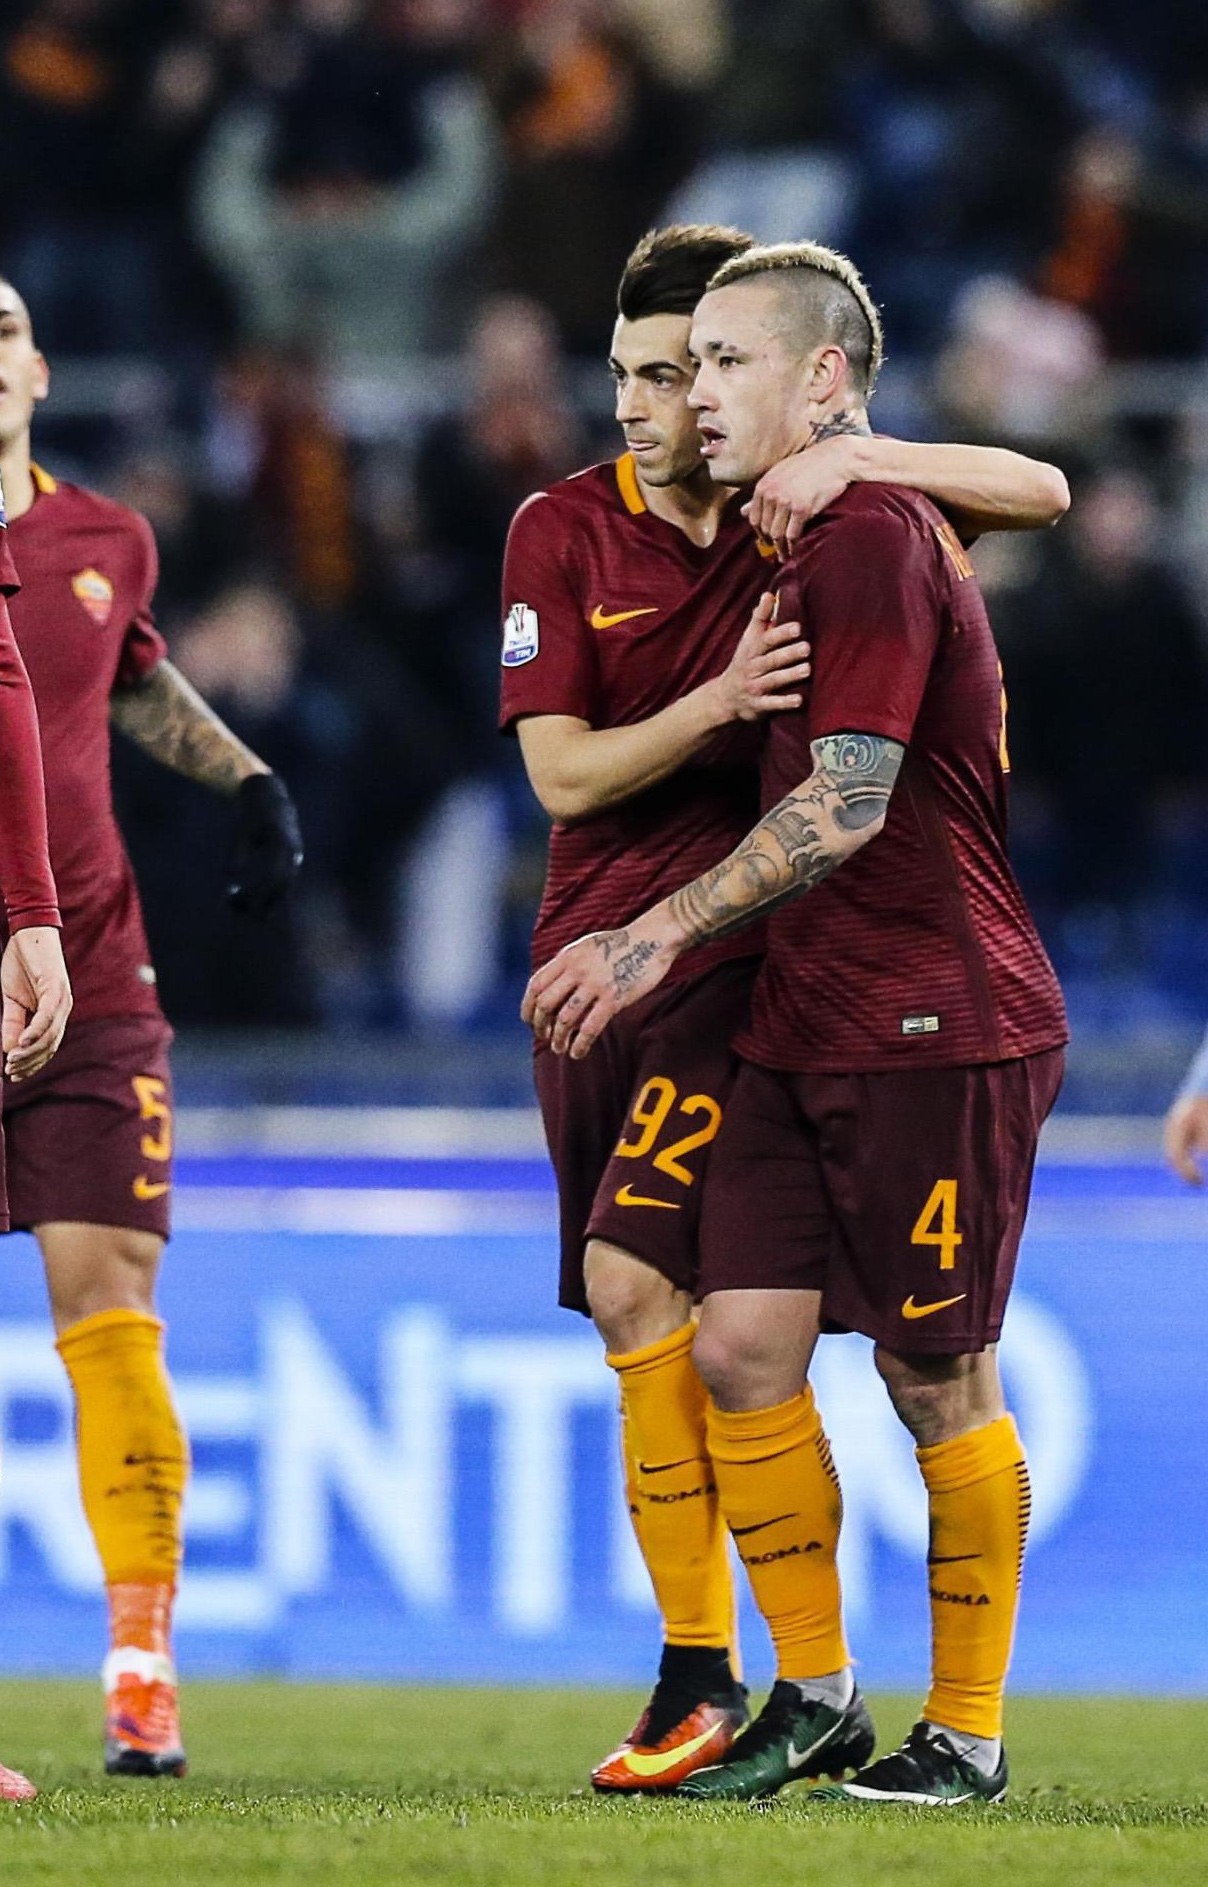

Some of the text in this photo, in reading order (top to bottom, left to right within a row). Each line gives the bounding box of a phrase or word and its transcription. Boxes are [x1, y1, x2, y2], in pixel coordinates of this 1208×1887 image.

[132, 1075, 172, 1162] 5
[614, 1075, 723, 1187] 92
[911, 1178, 963, 1270] 4
